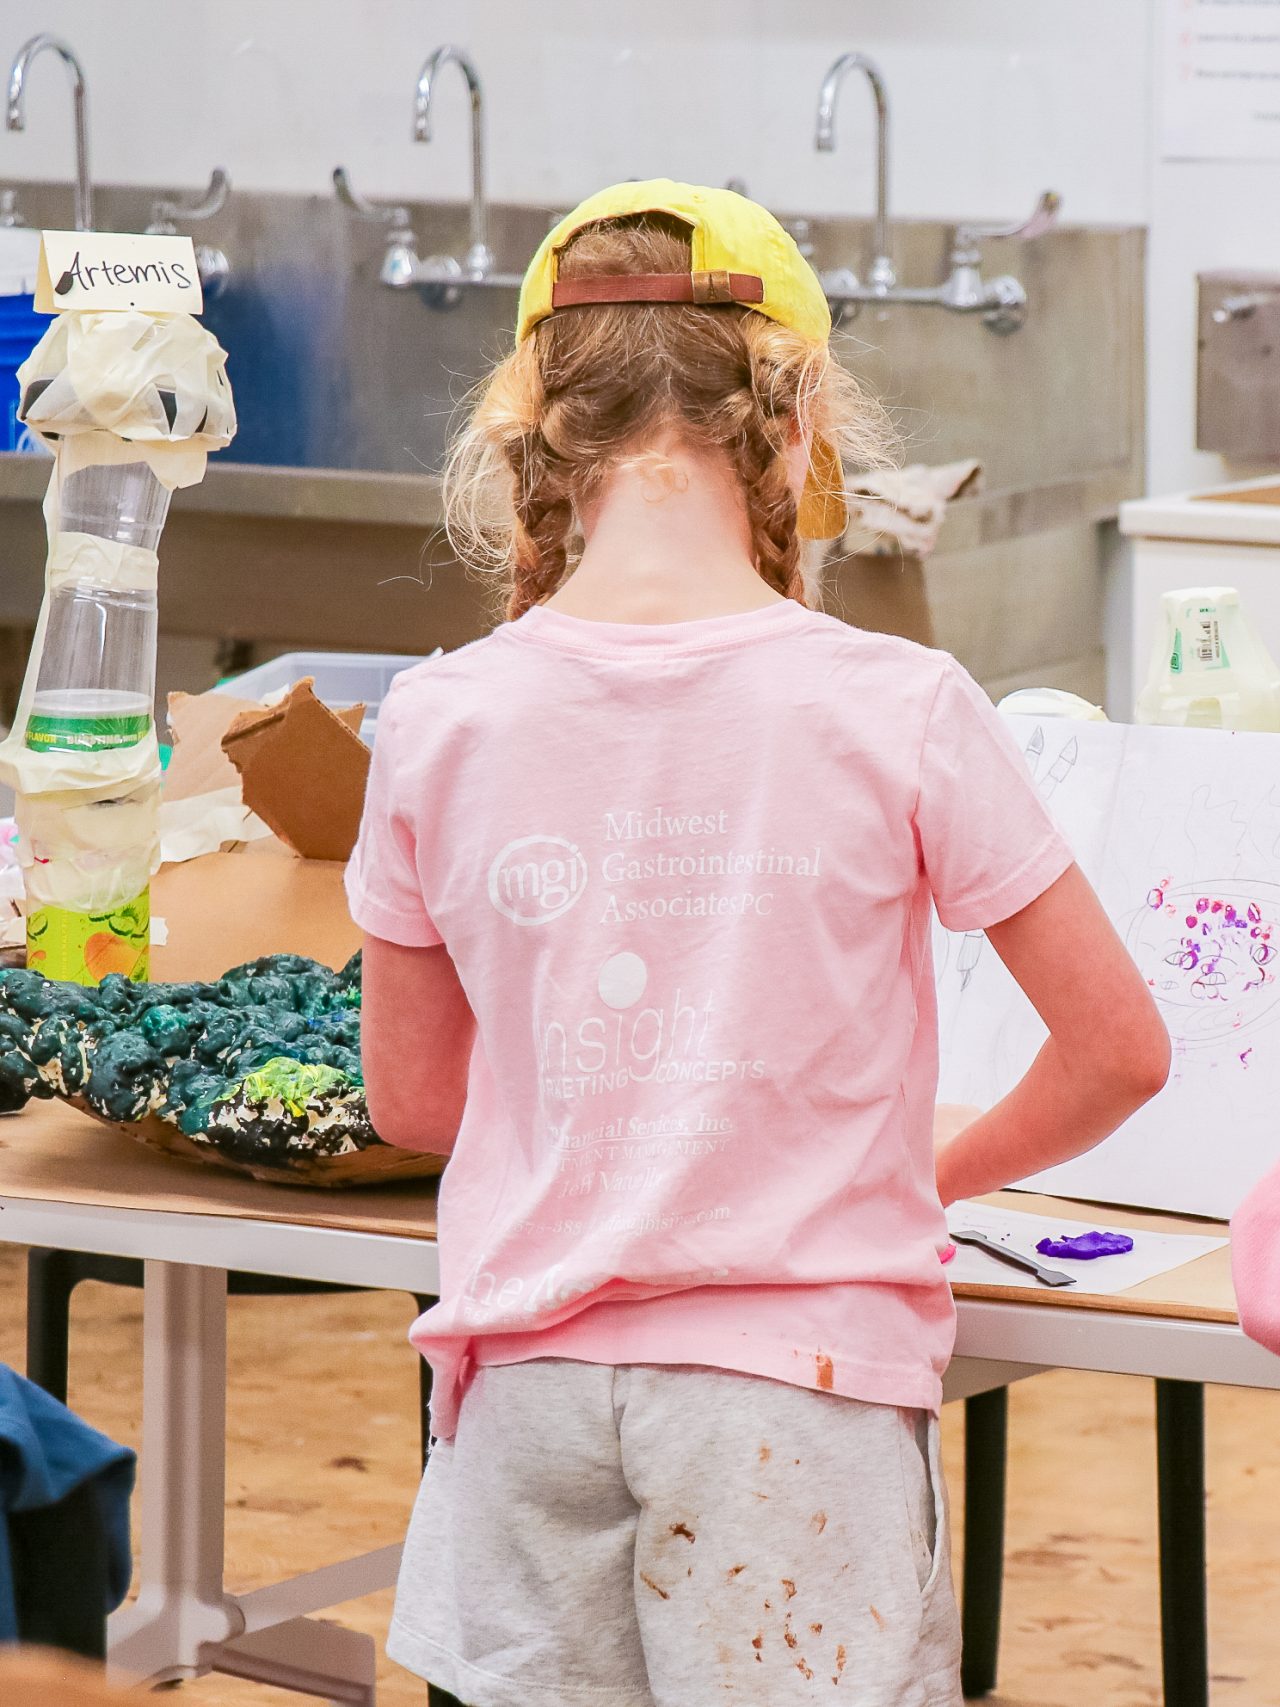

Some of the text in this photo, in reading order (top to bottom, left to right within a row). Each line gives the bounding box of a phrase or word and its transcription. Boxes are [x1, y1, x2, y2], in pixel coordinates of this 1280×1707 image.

[67, 252, 191, 289] Artemis
[604, 806, 729, 841] Midwest
[497, 843, 580, 910] mgi
[601, 847, 822, 882] Gastrointestinal
[543, 988, 715, 1082] nsight
[656, 1060, 766, 1084] CONCEPTS
[696, 1112, 734, 1131] Inc.
